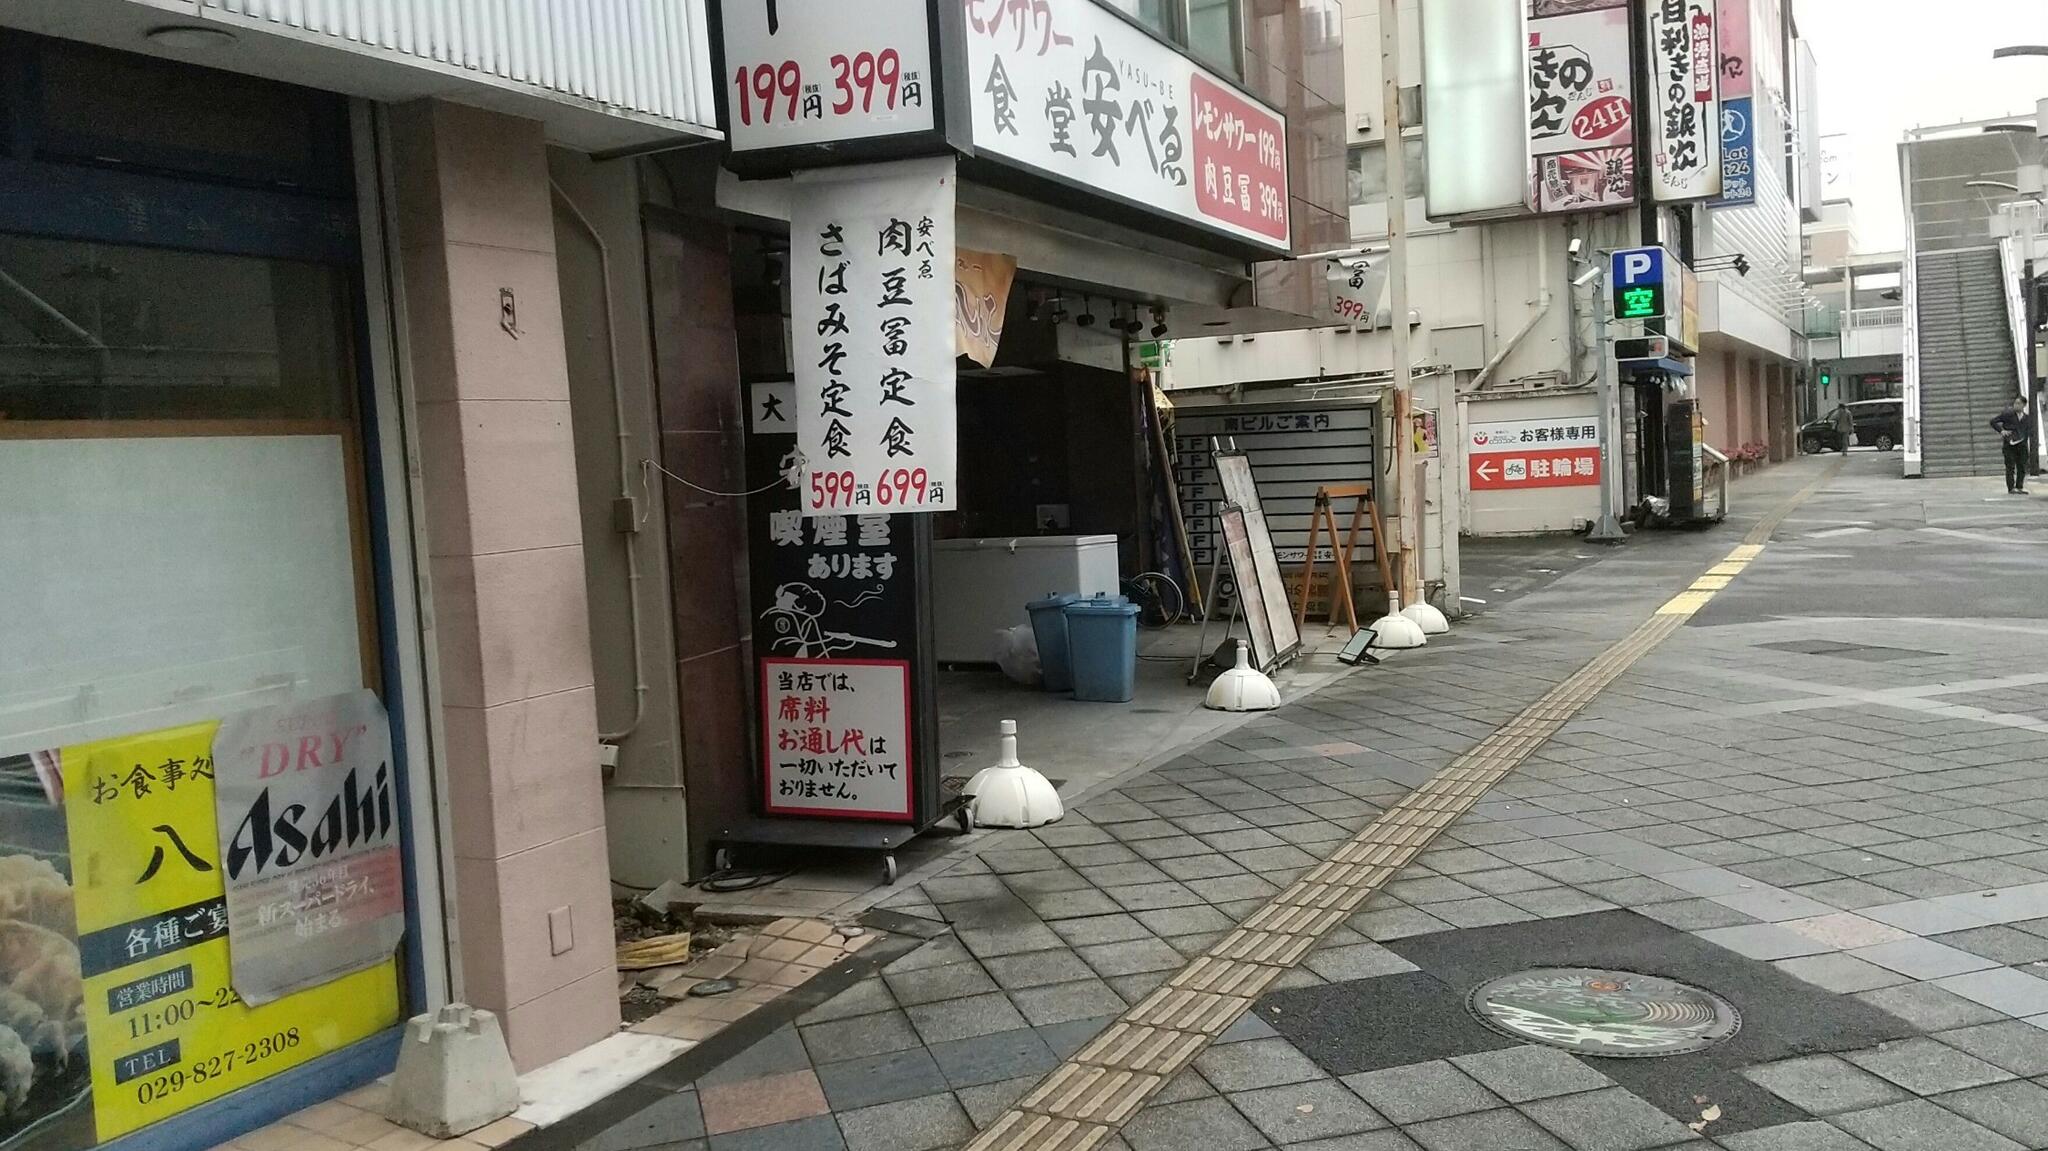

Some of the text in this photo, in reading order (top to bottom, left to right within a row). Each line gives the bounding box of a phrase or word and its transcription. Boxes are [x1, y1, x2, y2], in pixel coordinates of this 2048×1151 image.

[1660, 0, 1698, 172] 目利きの銀次
[1193, 91, 1257, 152] レモンサワー
[1574, 98, 1630, 138] 24H
[1625, 253, 1652, 284] P
[1624, 287, 1654, 316] 空
[816, 222, 854, 459] さばみそ定食
[1519, 425, 1596, 443] お客様専用
[1530, 456, 1594, 479] 駐輪場
[769, 508, 891, 547] 喫煙室
[808, 552, 898, 581] あります
[778, 694, 831, 724] 席料
[778, 727, 887, 756] お通し代は
[93, 756, 214, 805] お食事処
[779, 758, 898, 780] 一切いただいて
[227, 760, 391, 881] Asahi
[135, 824, 213, 885] 八
[124, 905, 228, 959] 各種ご宴
[115, 971, 186, 1008] 営業時間
[124, 1048, 171, 1078] TEL
[138, 1026, 301, 1105] 029-827-2308
